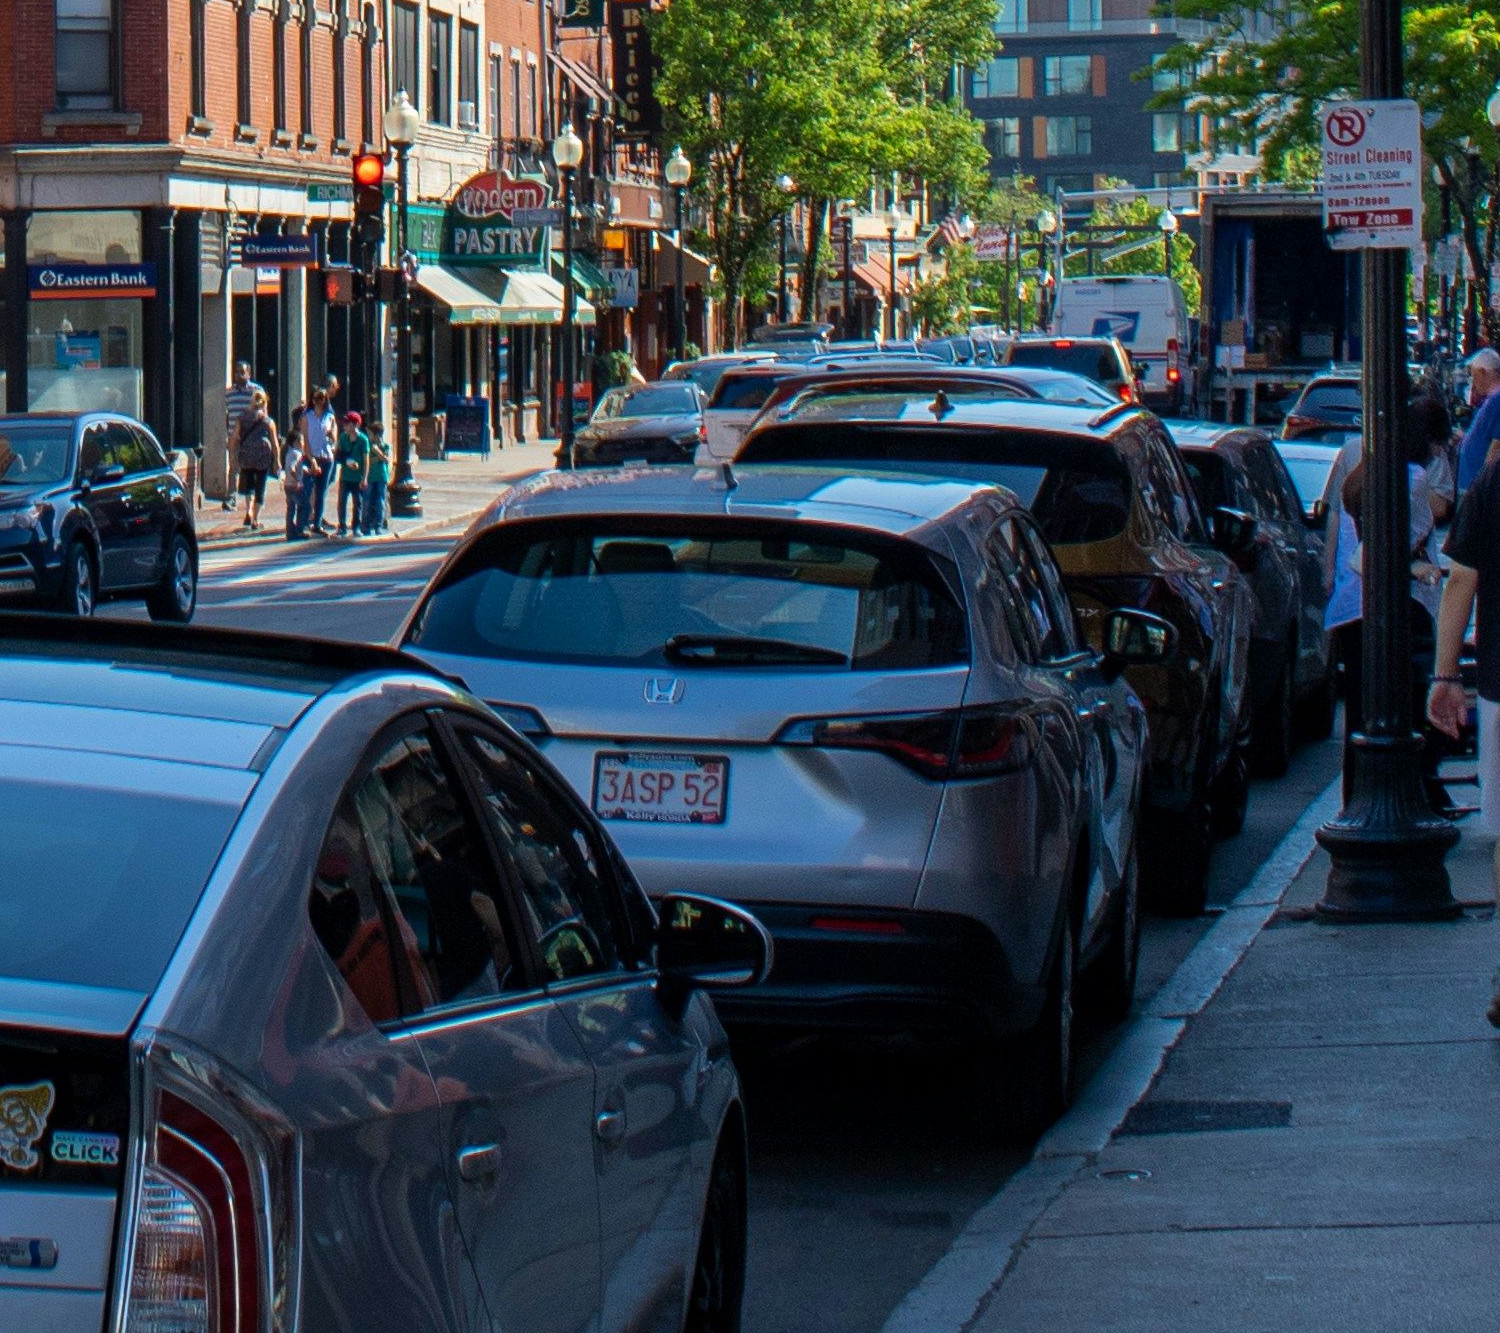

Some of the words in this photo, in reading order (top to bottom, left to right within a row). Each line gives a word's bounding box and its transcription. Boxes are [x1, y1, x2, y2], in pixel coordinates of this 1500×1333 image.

[1326, 150, 1361, 166] Street
[1365, 147, 1413, 165] Cleaning
[1368, 170, 1401, 181] TUESDAY
[1333, 214, 1359, 226] Tow
[1366, 213, 1399, 226] Zone
[454, 227, 538, 254] PASTRY
[57, 273, 108, 286] Eastern
[111, 272, 147, 286] Bank
[602, 770, 675, 804] 3ASP
[684, 772, 720, 807] 52
